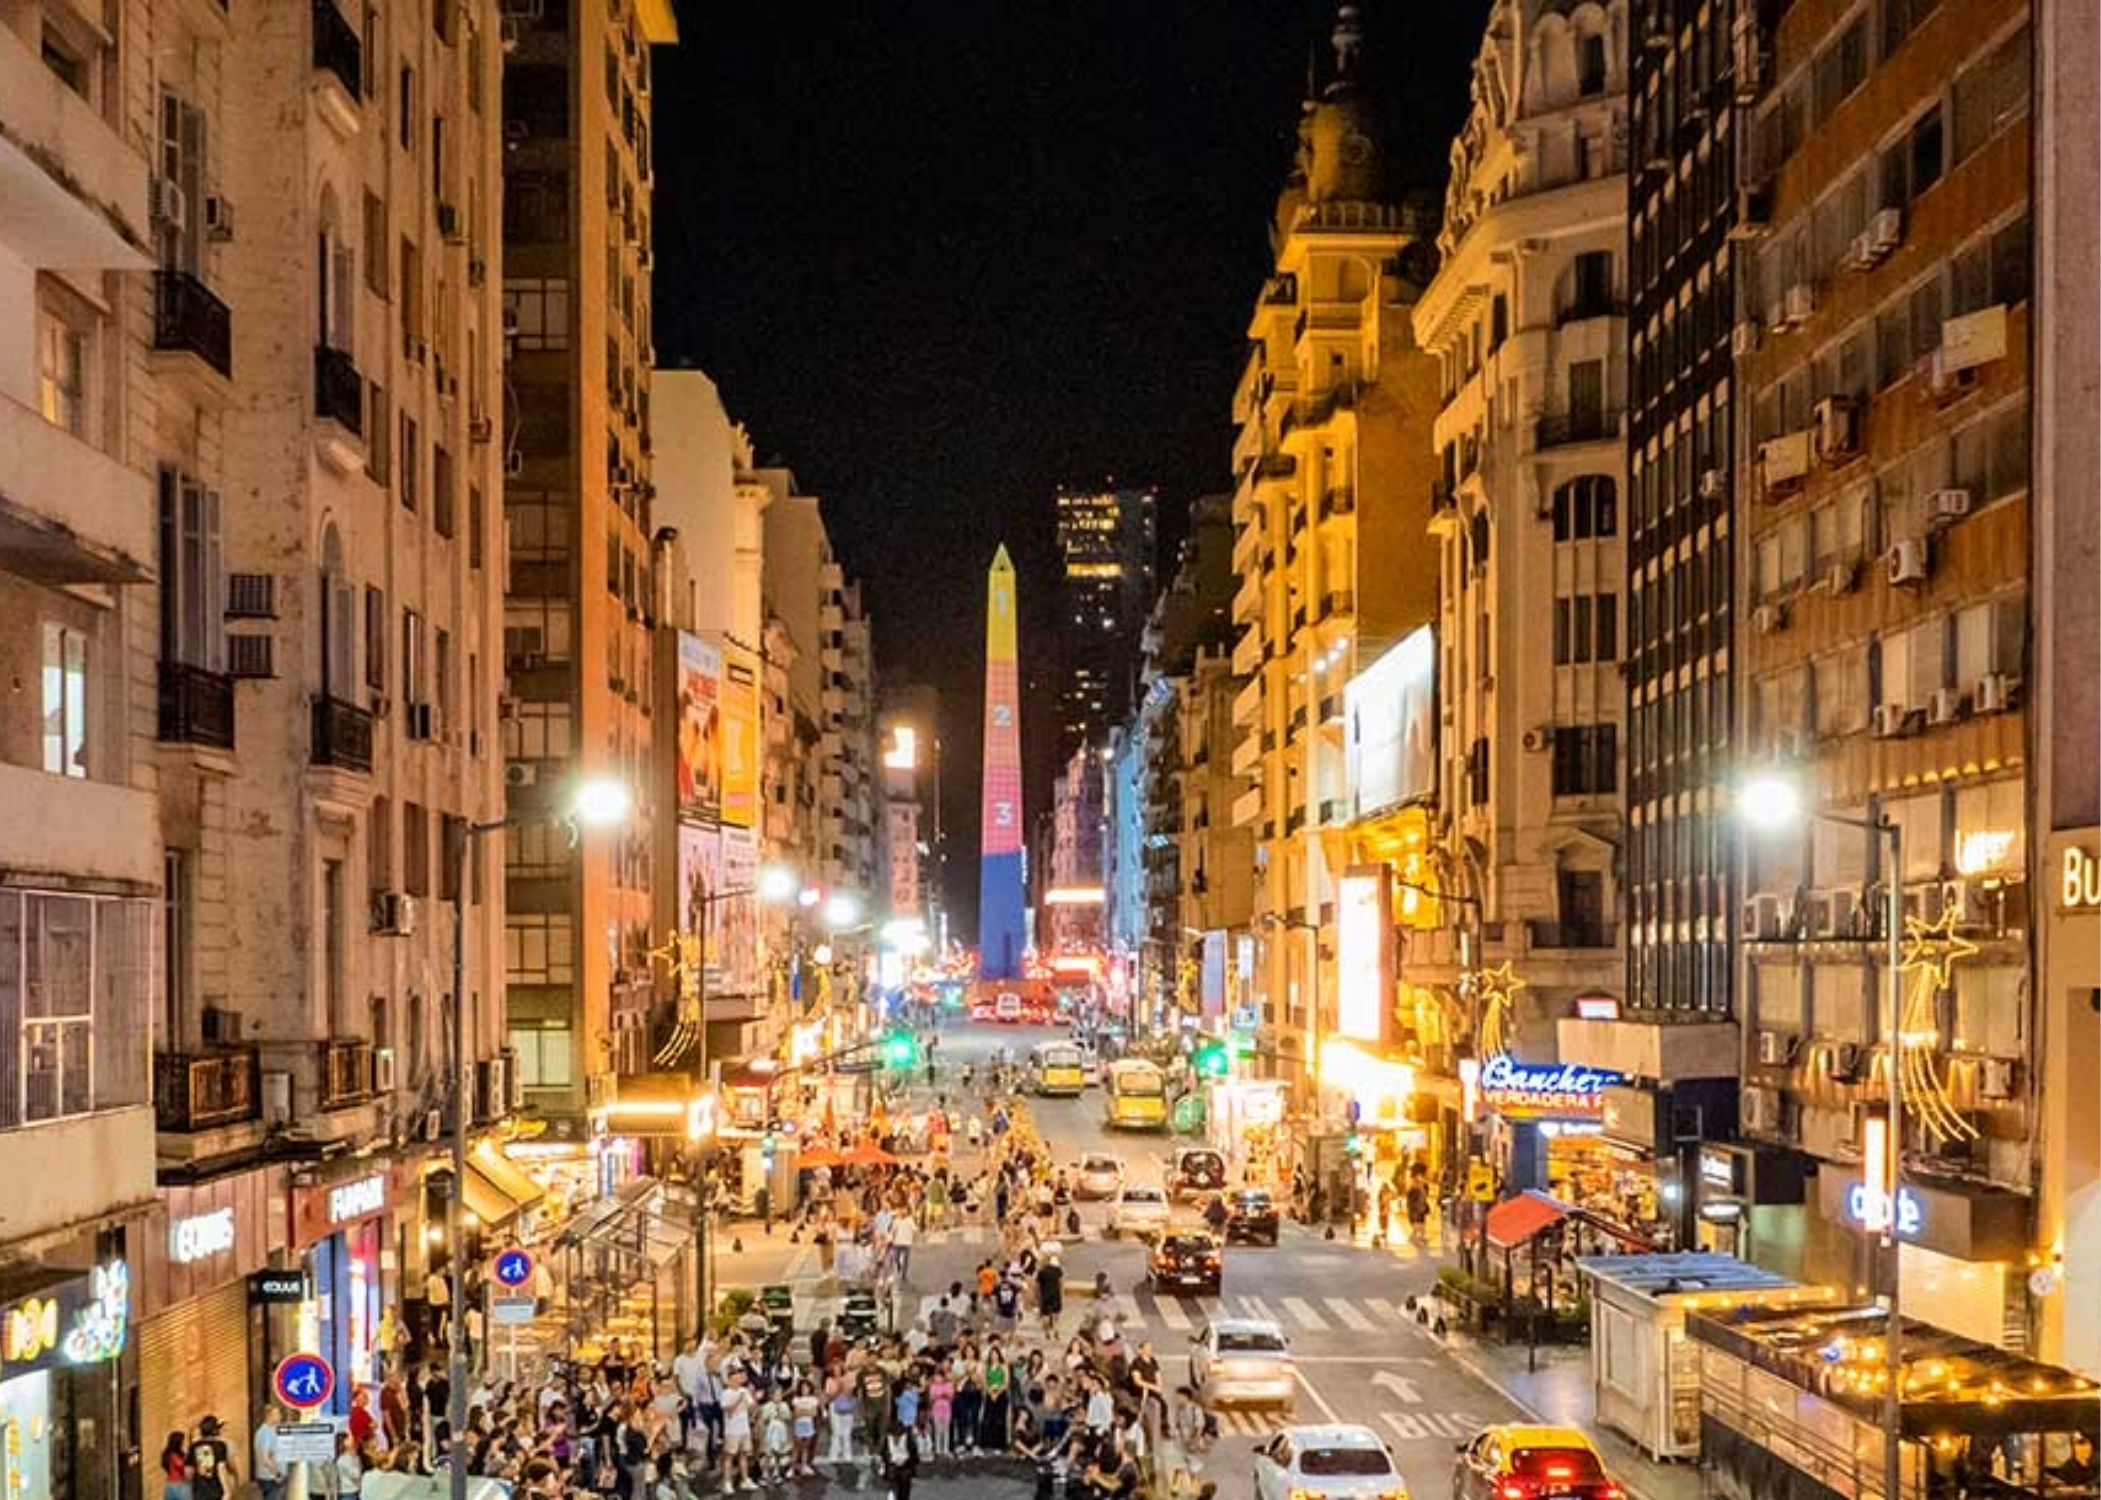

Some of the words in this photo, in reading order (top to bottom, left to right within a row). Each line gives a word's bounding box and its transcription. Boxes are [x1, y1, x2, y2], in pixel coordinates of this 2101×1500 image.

[993, 705, 1013, 727] 2
[994, 801, 1013, 826] 3
[1485, 1091, 1589, 1108] VERDADERA
[1379, 1412, 1482, 1439] BUS
